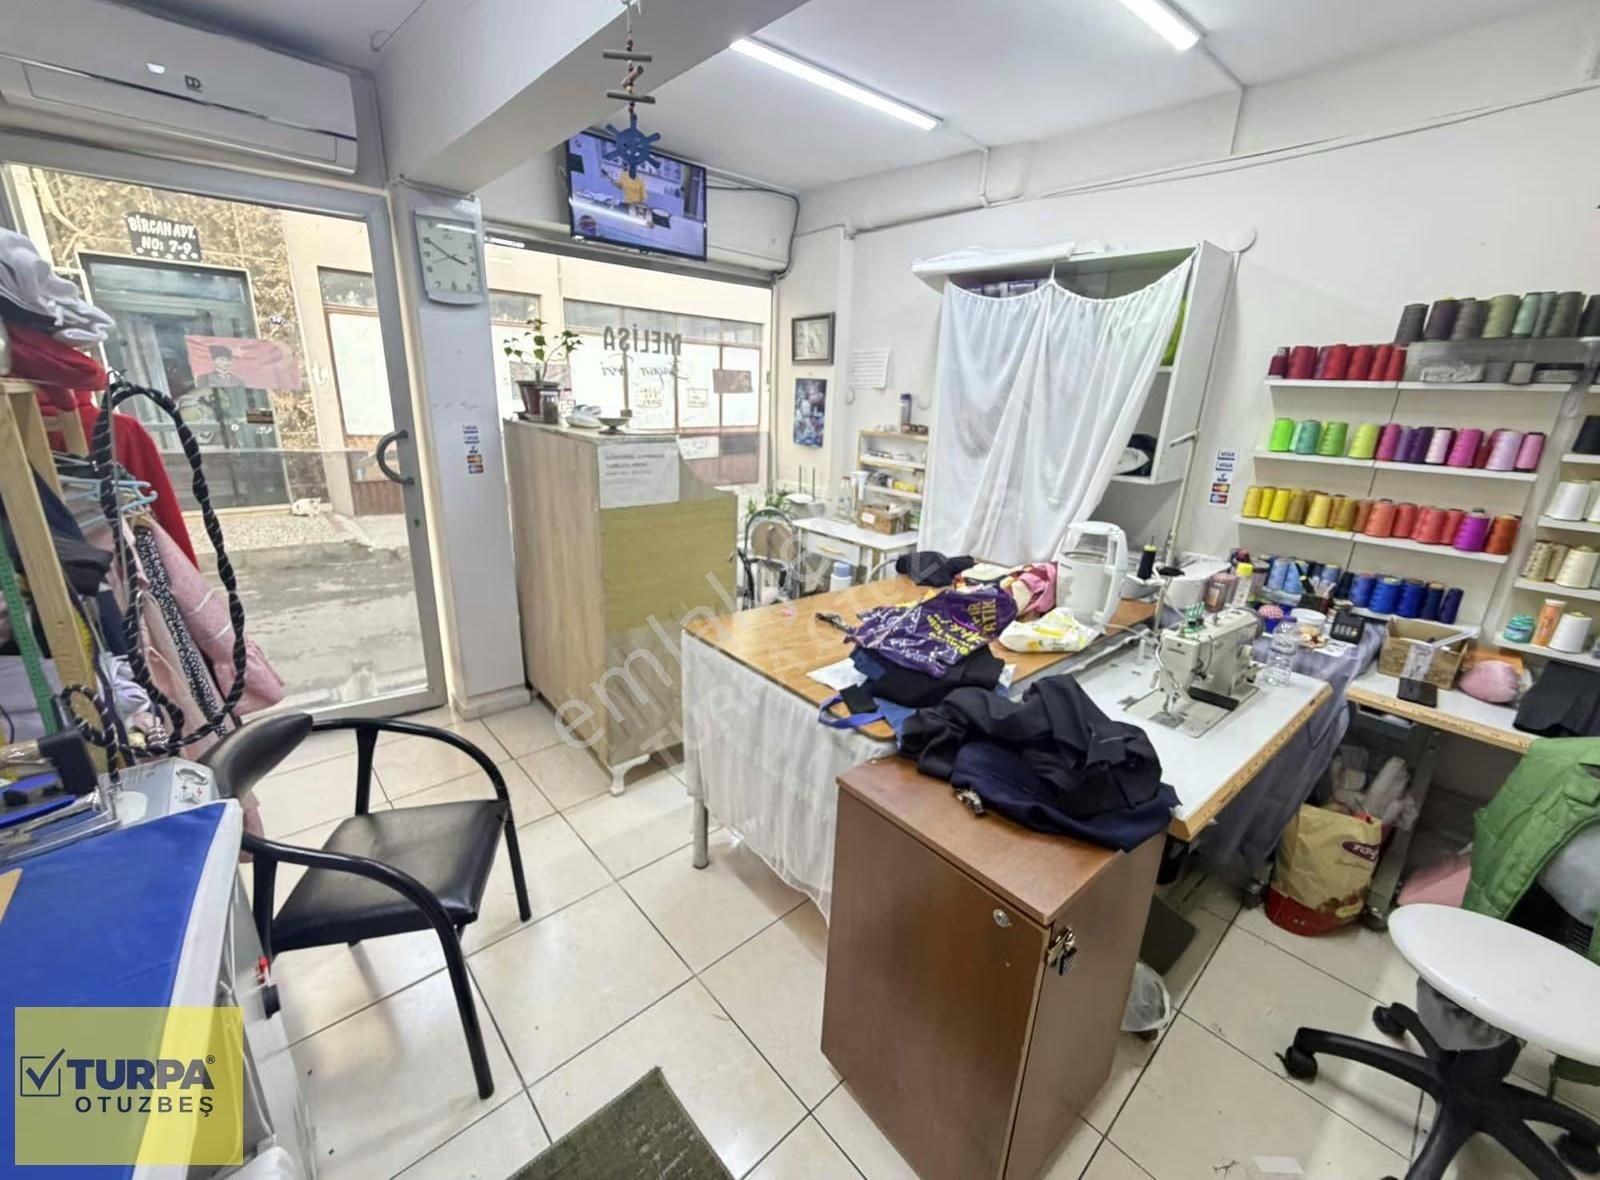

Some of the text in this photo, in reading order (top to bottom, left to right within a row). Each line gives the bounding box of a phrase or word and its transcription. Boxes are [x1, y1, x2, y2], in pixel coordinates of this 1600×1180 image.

[127, 214, 196, 240] BİRCAN APT.
[141, 235, 192, 255] NO: 7-9
